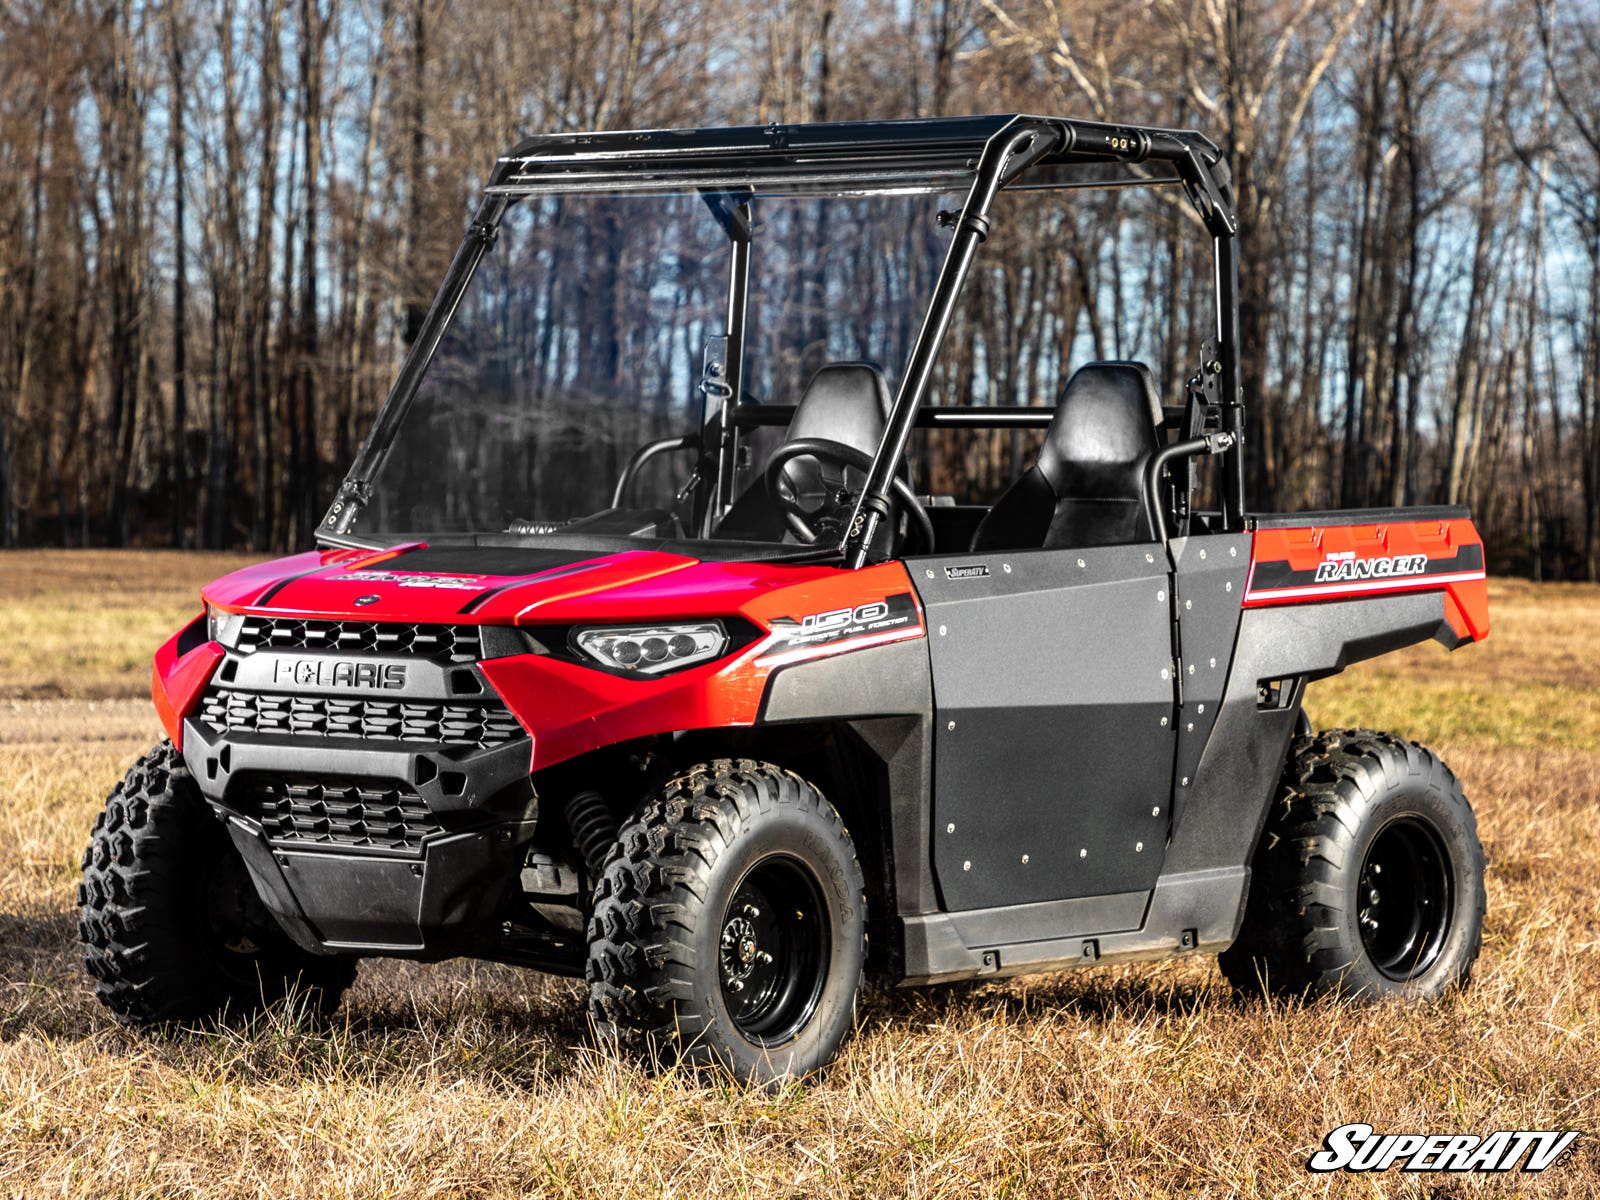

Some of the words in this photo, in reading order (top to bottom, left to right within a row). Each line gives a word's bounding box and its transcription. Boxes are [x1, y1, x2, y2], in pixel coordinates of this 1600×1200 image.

[1315, 554, 1427, 582] RANGER
[800, 601, 889, 635] 150
[843, 624, 866, 635] FUEL
[868, 616, 908, 630] INJECTION
[273, 658, 408, 690] POLARIS
